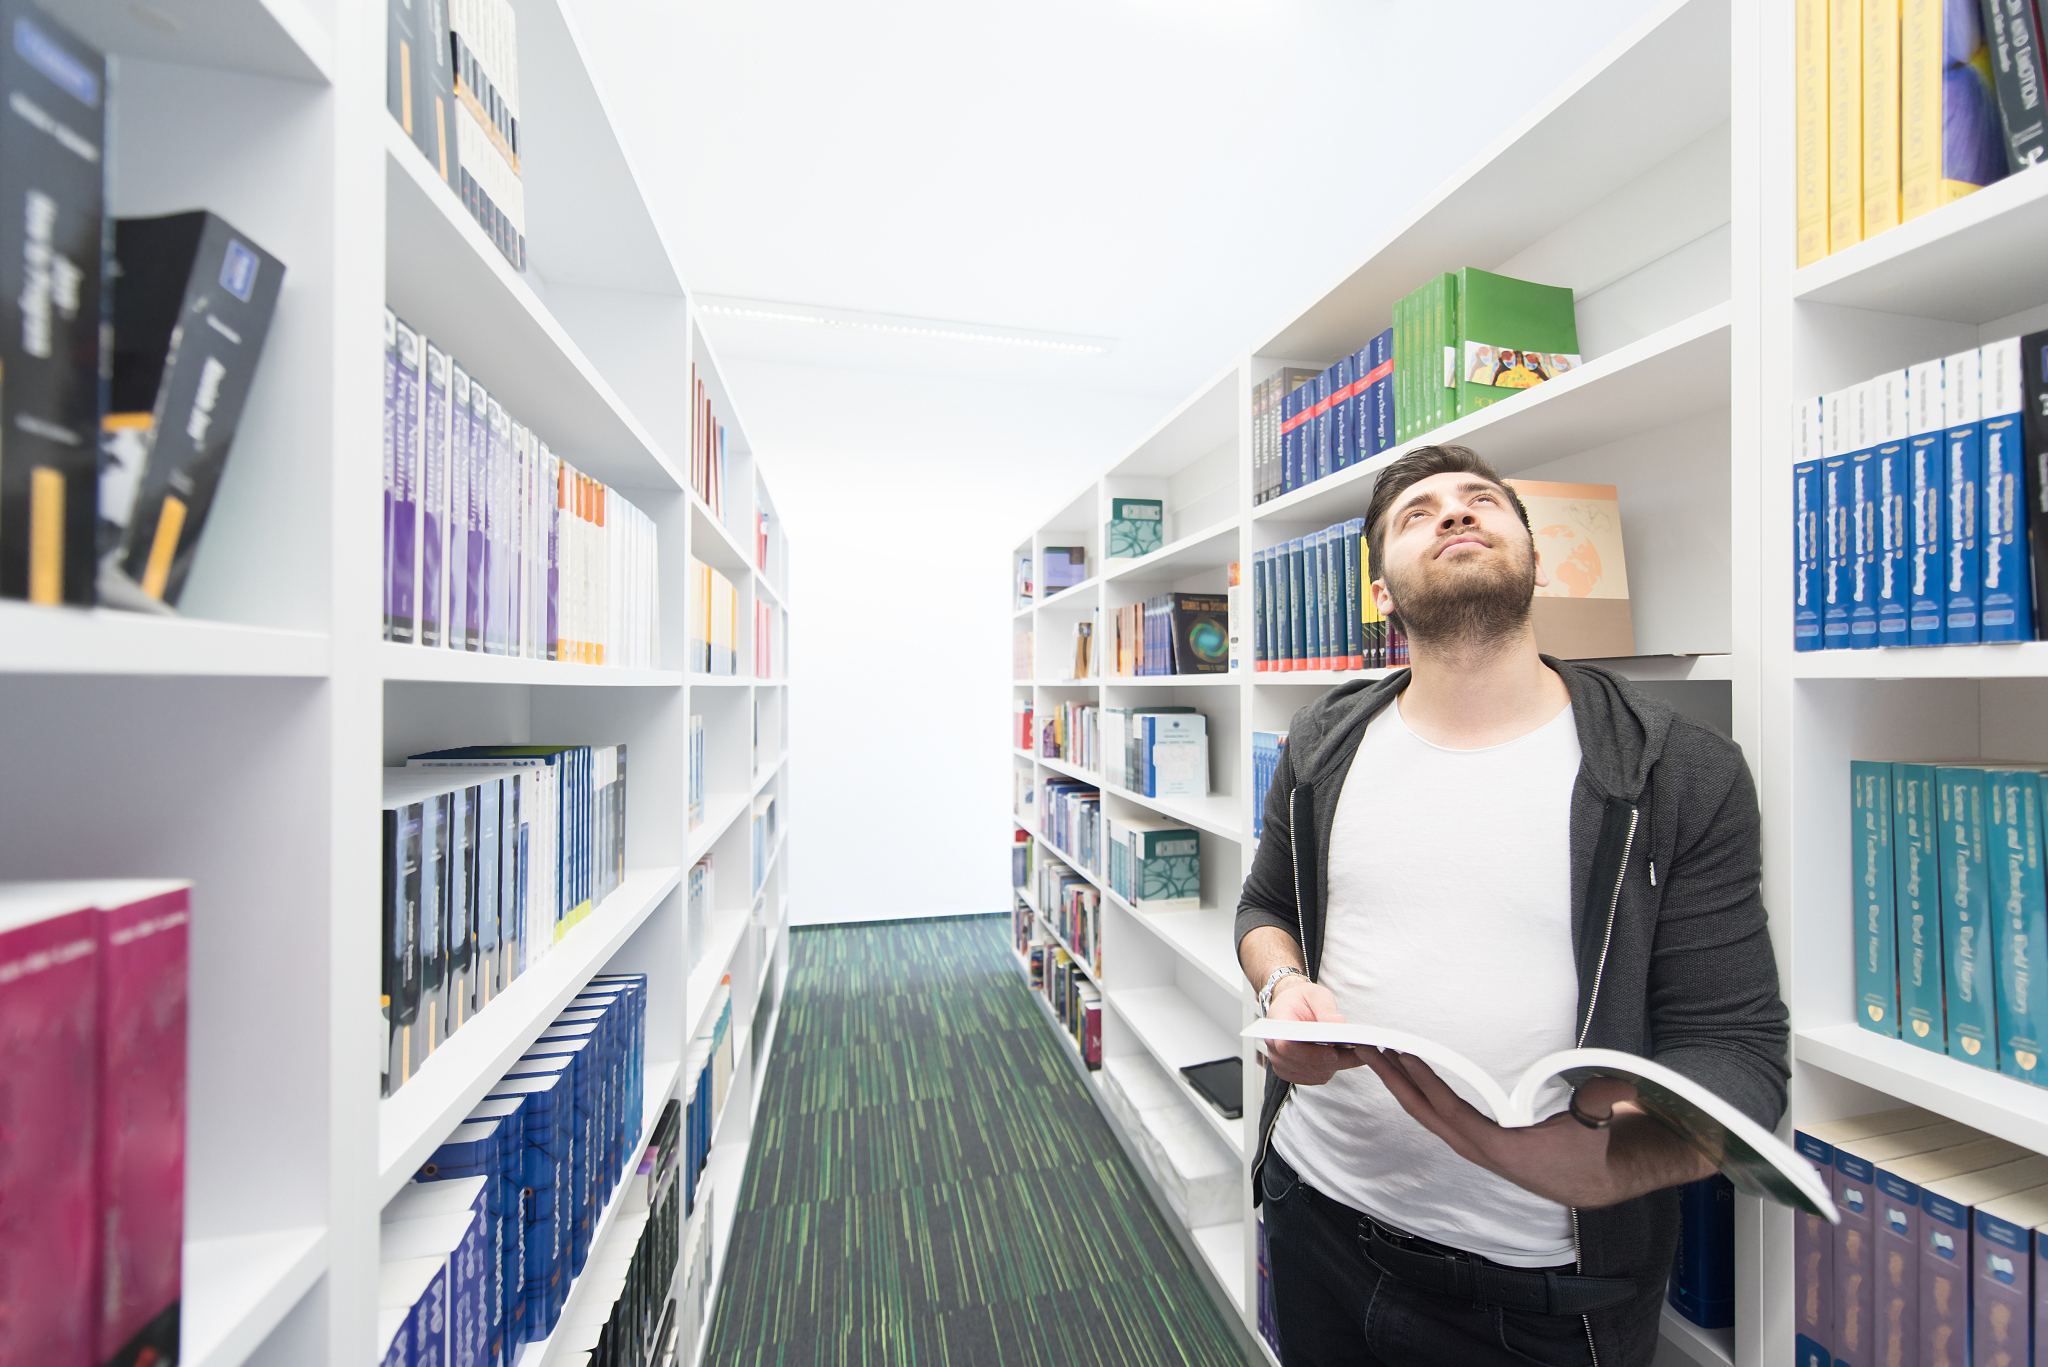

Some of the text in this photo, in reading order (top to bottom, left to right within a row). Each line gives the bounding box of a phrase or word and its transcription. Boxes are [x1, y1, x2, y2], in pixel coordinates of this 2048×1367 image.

[2015, 46, 2039, 110] EMOTION
[396, 371, 408, 502] Programming
[1377, 382, 1386, 438] Psychology
[408, 422, 418, 503] Network
[425, 391, 437, 514] Programming
[436, 440, 446, 513] Network
